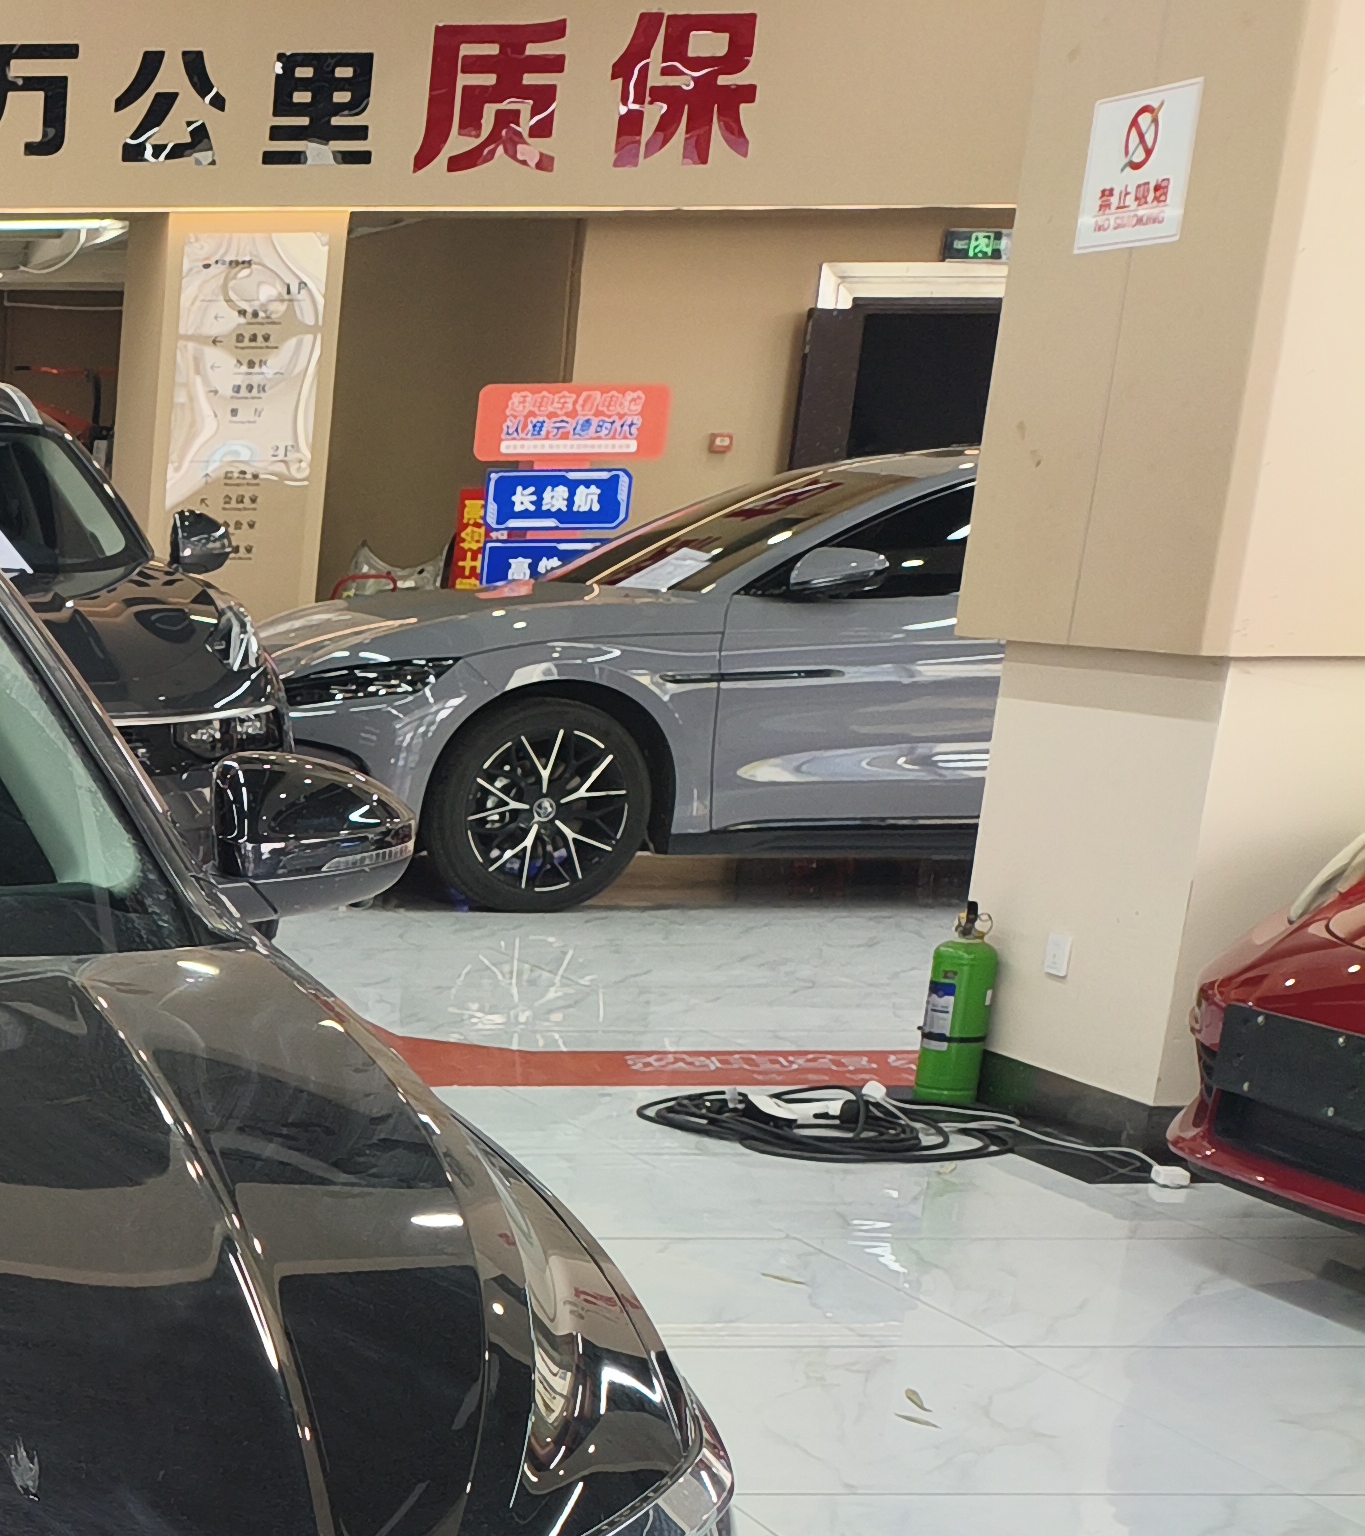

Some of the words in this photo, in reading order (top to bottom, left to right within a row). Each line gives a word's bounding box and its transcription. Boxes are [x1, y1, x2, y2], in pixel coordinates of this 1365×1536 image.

[1097, 177, 1171, 215] 禁止吸烟
[510, 484, 601, 513] 长续航
